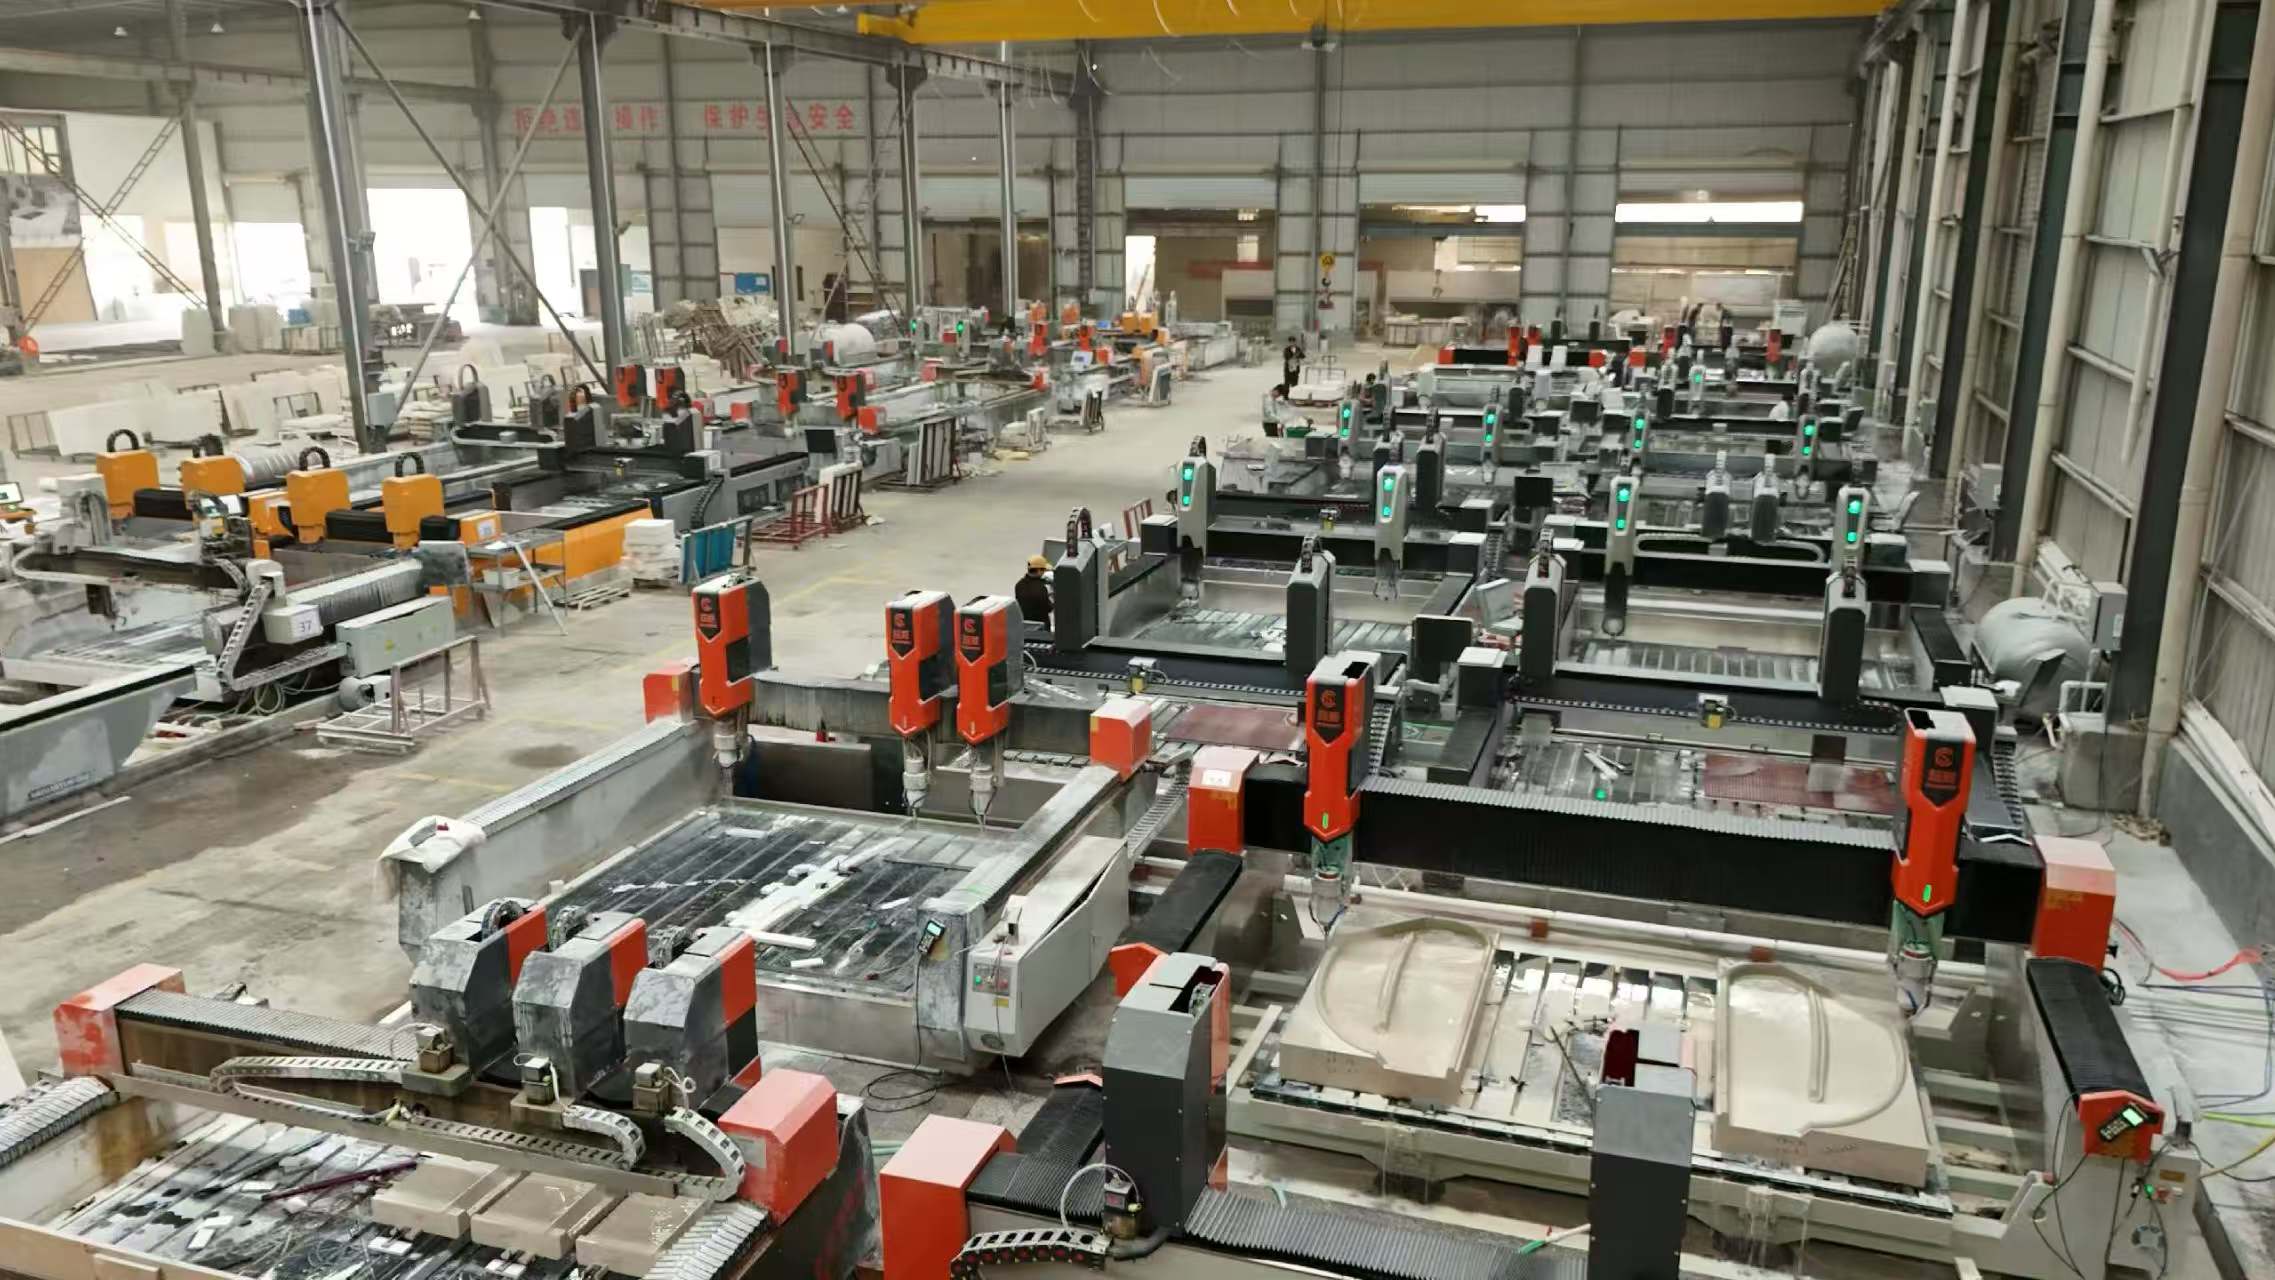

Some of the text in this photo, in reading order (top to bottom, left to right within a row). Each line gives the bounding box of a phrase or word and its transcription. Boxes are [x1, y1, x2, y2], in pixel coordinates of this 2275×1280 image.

[513, 105, 658, 131] 拒绝违操作
[299, 620, 312, 633] 37
